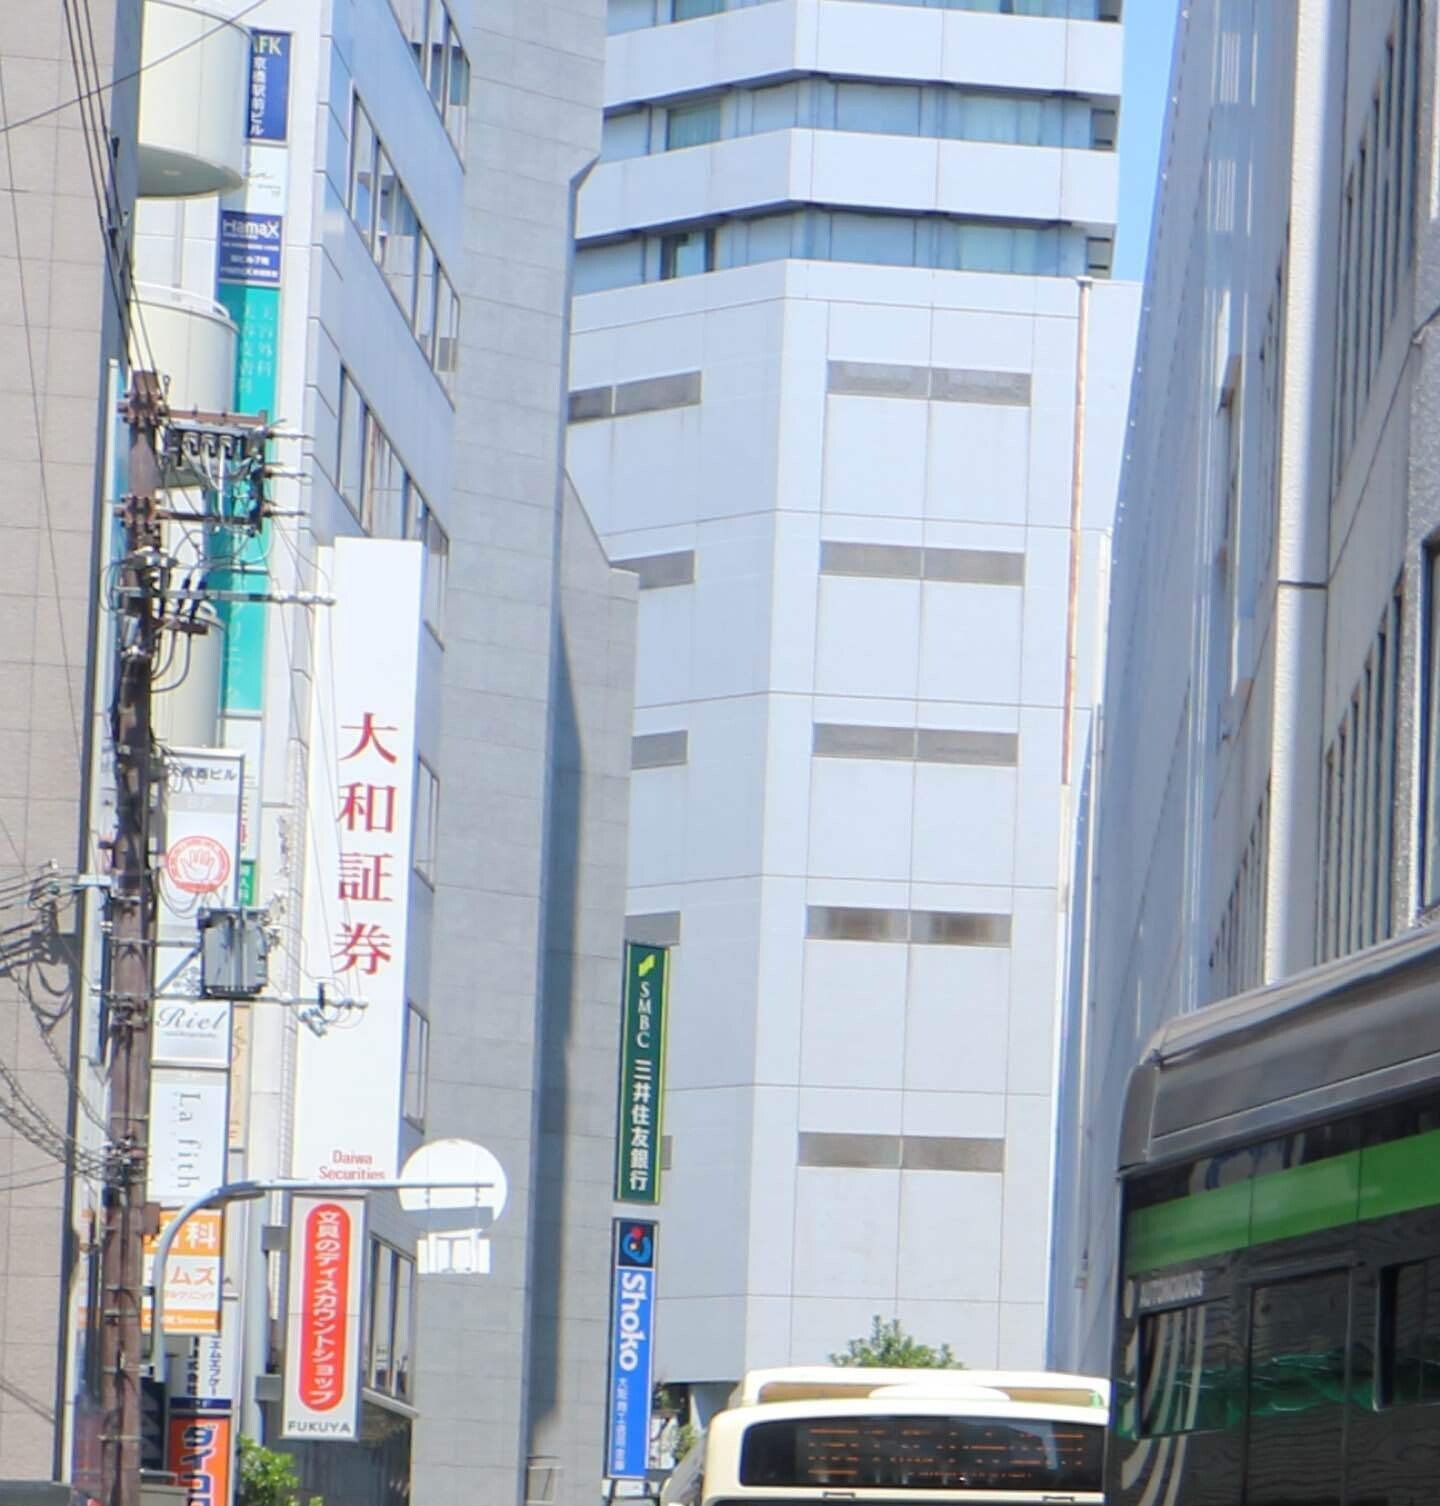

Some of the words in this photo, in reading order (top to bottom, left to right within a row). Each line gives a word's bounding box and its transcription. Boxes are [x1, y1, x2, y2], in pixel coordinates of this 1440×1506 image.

[335, 711, 398, 977] 大和証券
[637, 981, 652, 1049] SMBC
[333, 1149, 374, 1166] Daiwa
[629, 1059, 652, 1192] 三井住友銀行
[319, 1166, 386, 1181] Securities
[308, 1210, 341, 1407] 文具のディスカウントショップ
[619, 1272, 647, 1372] Shoko
[288, 1420, 351, 1433] FUKUYA
